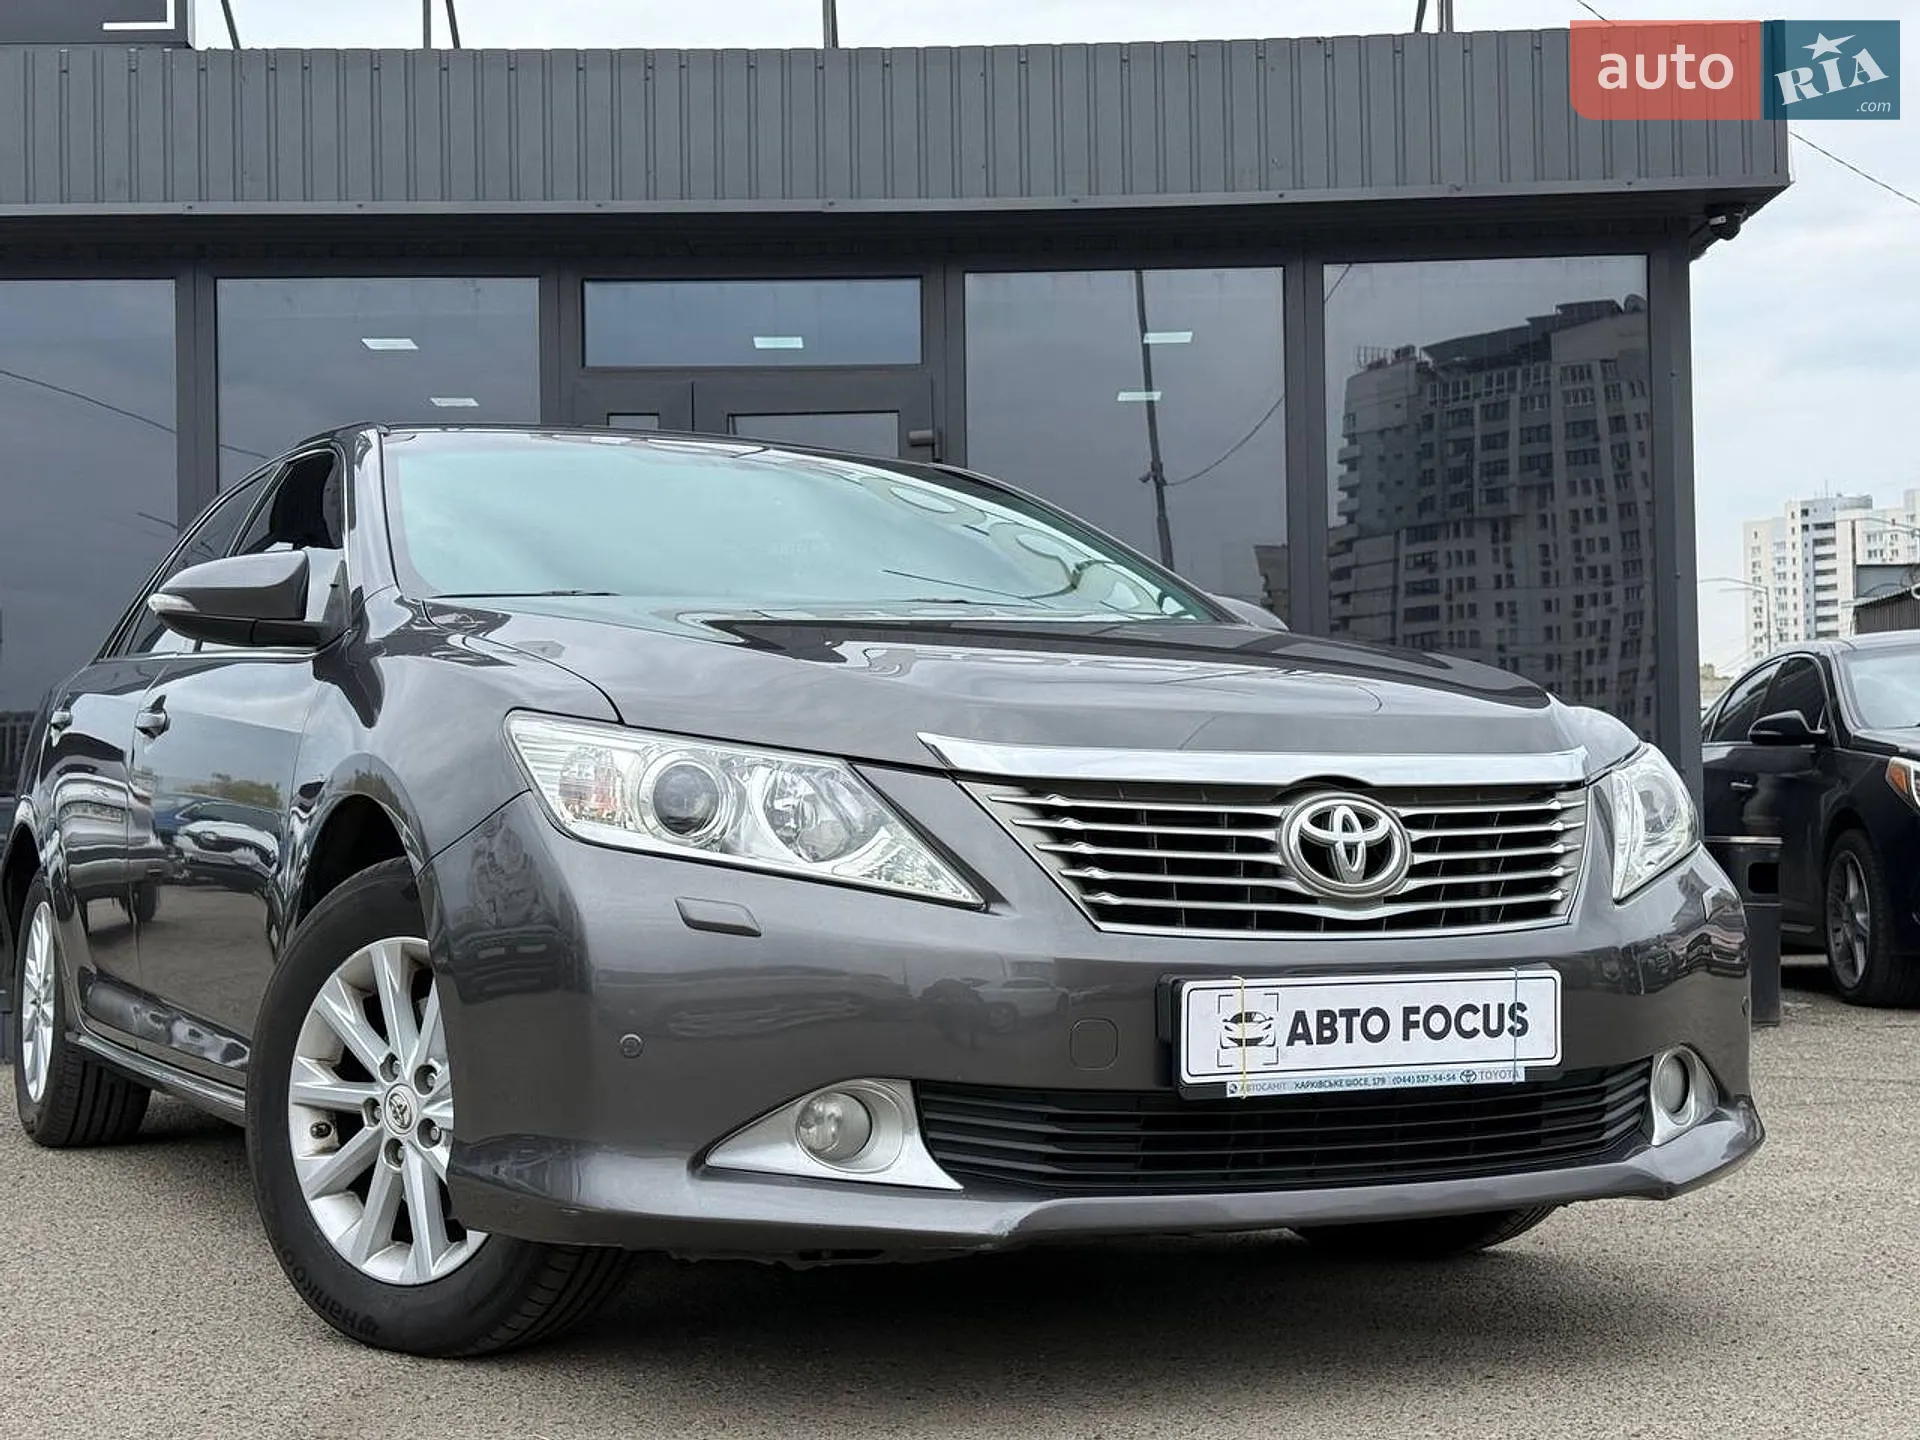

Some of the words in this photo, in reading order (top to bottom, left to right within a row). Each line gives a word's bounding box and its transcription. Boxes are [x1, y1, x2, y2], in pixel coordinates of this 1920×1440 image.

[1286, 1006, 1391, 1047] АВТО
[1401, 1001, 1530, 1042] FOCUS
[1479, 1069, 1520, 1081] TOYOTA
